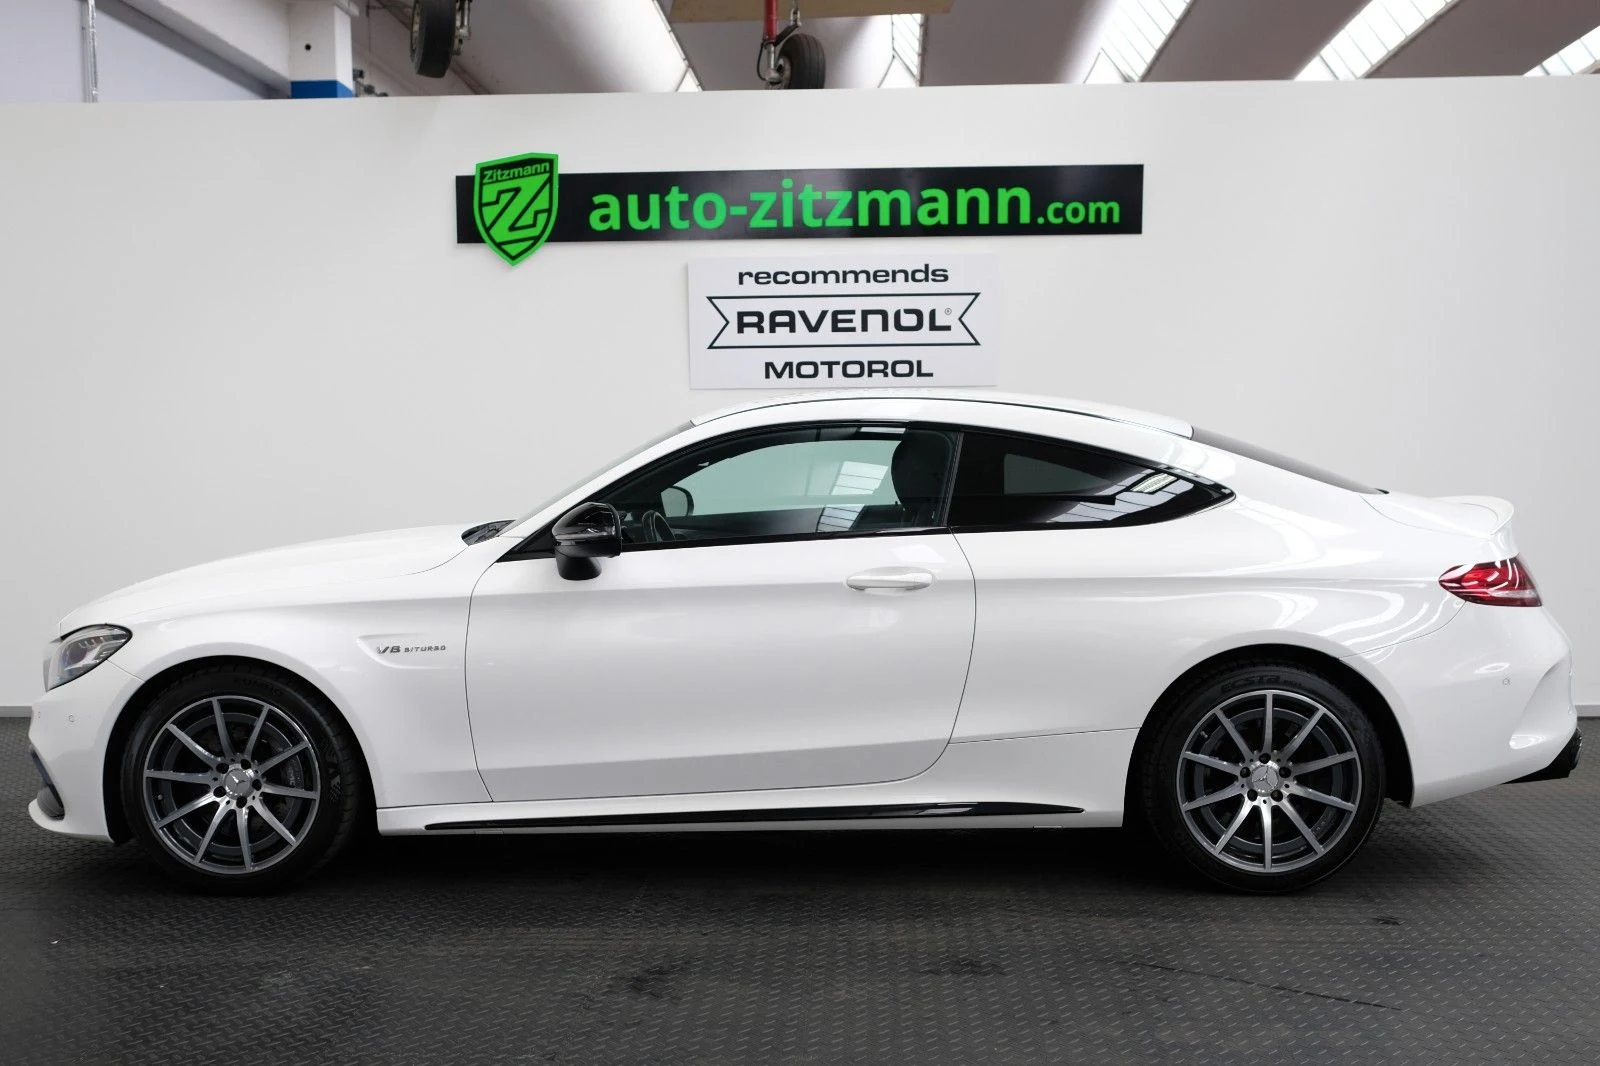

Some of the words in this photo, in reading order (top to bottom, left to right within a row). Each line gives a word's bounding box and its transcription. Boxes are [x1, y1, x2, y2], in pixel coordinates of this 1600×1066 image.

[483, 162, 550, 183] Zitzmann
[588, 178, 1121, 232] auto-zitzmann.com
[738, 263, 949, 285] recommends
[764, 359, 934, 379] MOTOROL
[376, 645, 401, 655] V8
[404, 645, 446, 653] BITURBO
